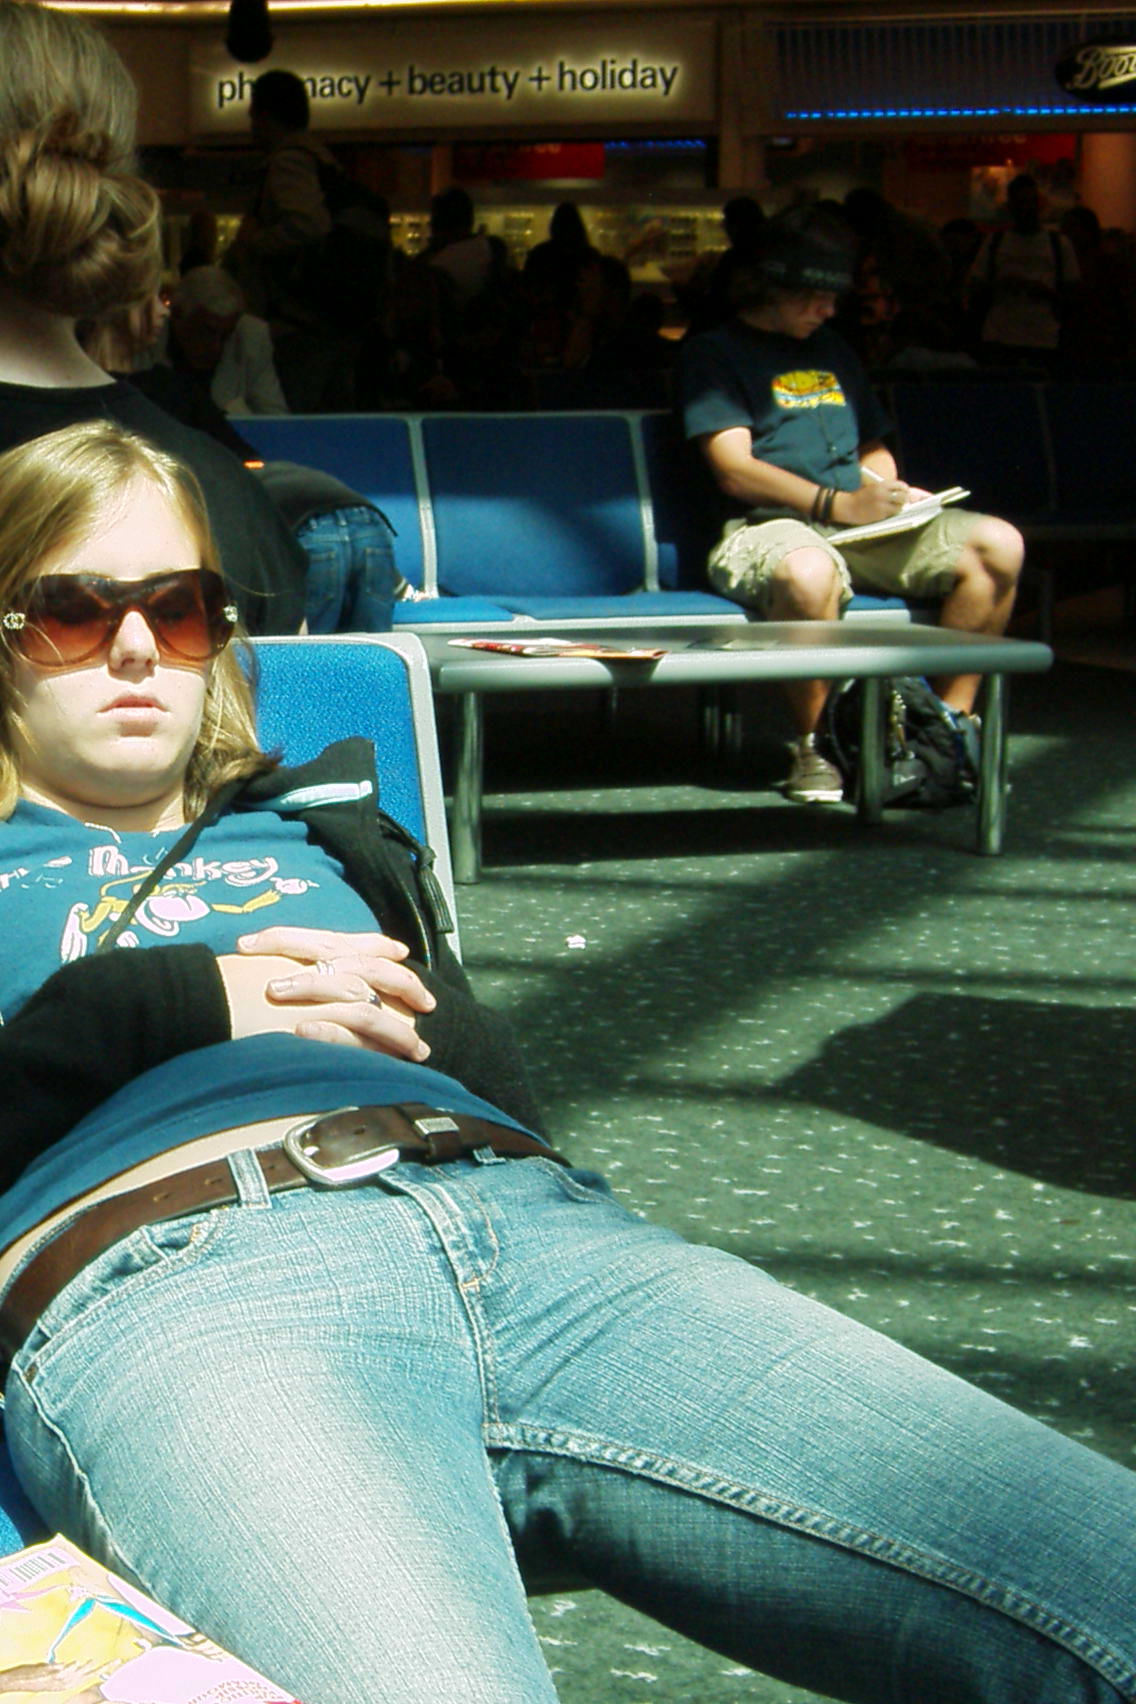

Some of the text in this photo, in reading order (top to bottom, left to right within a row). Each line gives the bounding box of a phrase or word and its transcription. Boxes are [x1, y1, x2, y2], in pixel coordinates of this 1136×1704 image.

[217, 70, 371, 109] phacy
[407, 64, 520, 100] beauty
[558, 58, 679, 96] holiday
